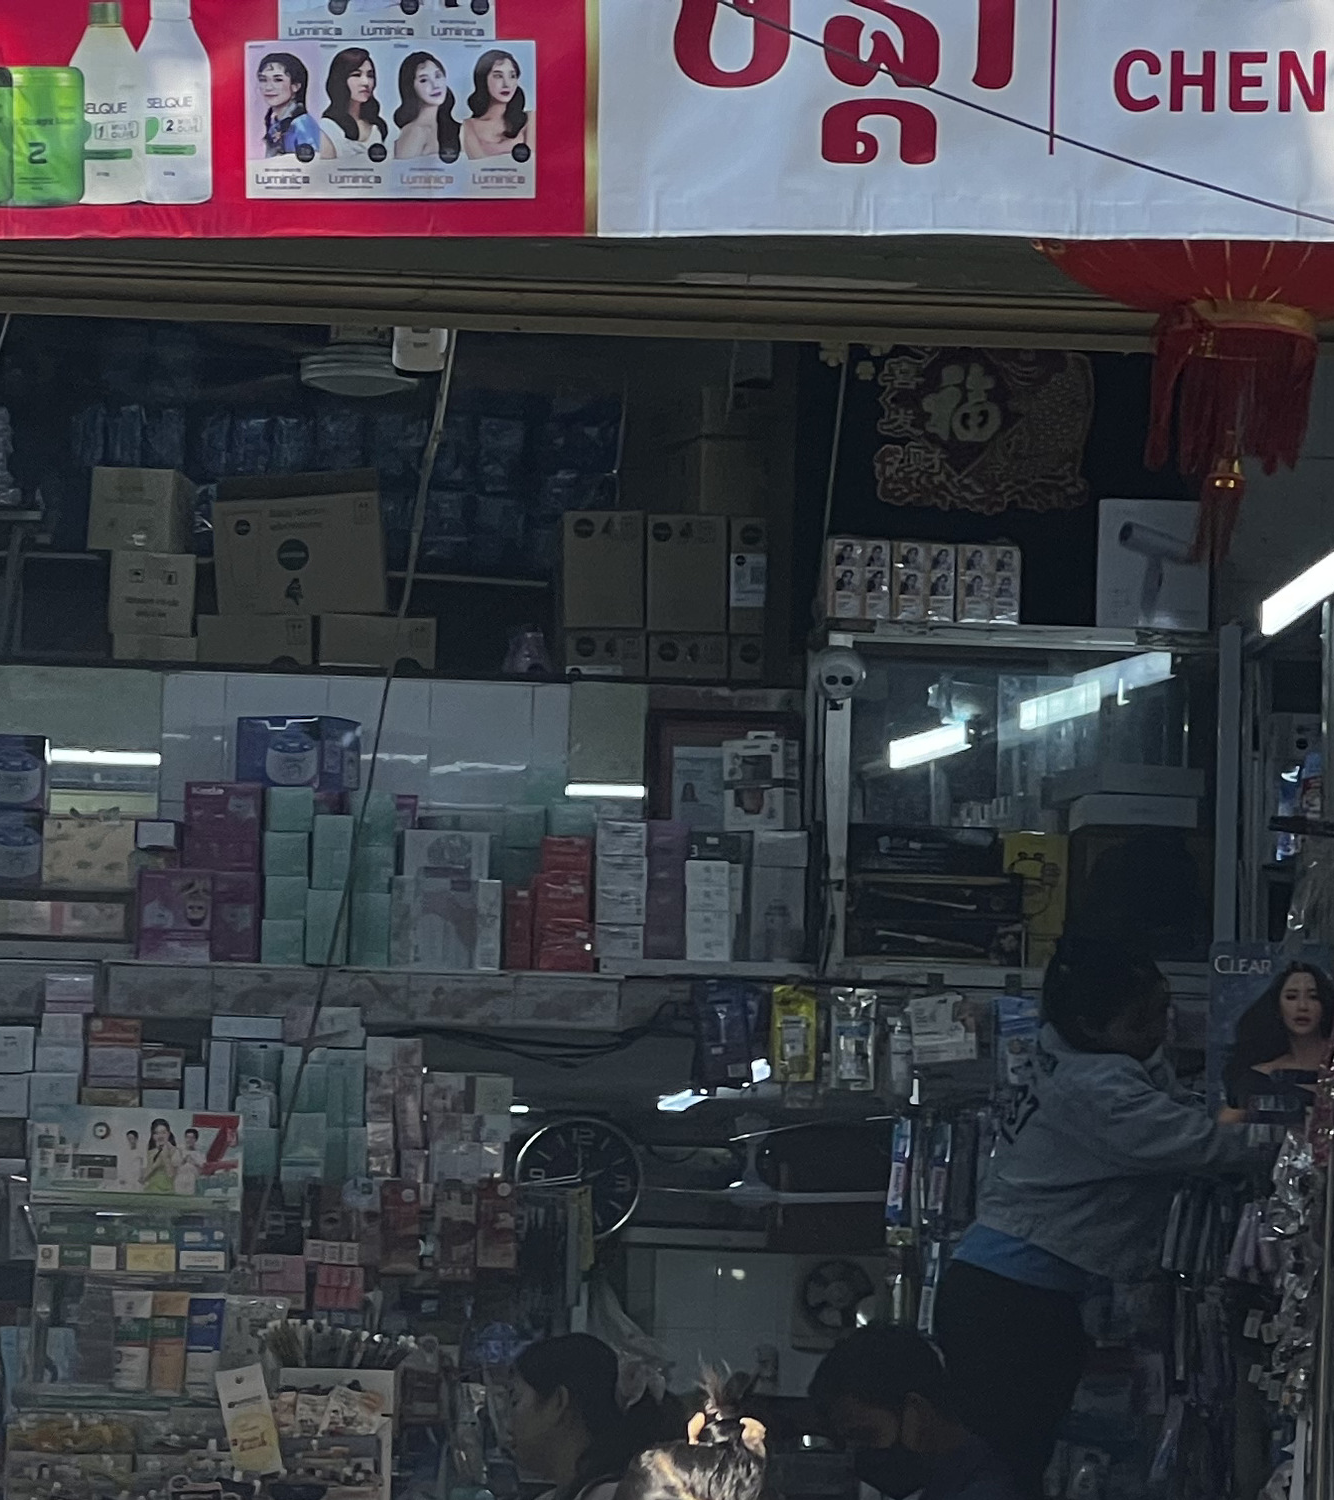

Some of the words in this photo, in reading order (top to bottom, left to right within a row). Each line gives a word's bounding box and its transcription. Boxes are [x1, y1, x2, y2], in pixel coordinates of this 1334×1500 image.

[147, 97, 192, 109] SELQUE
[29, 143, 46, 164] 2
[256, 174, 310, 185] Luminica
[329, 174, 381, 185] Luminica
[400, 174, 453, 185] Luminica
[472, 174, 525, 185] Luminica
[922, 363, 1001, 442] 福
[572, 1128, 595, 1145] 12
[193, 1114, 241, 1176] 7
[529, 1168, 546, 1183] 9
[612, 1175, 630, 1193] 3
